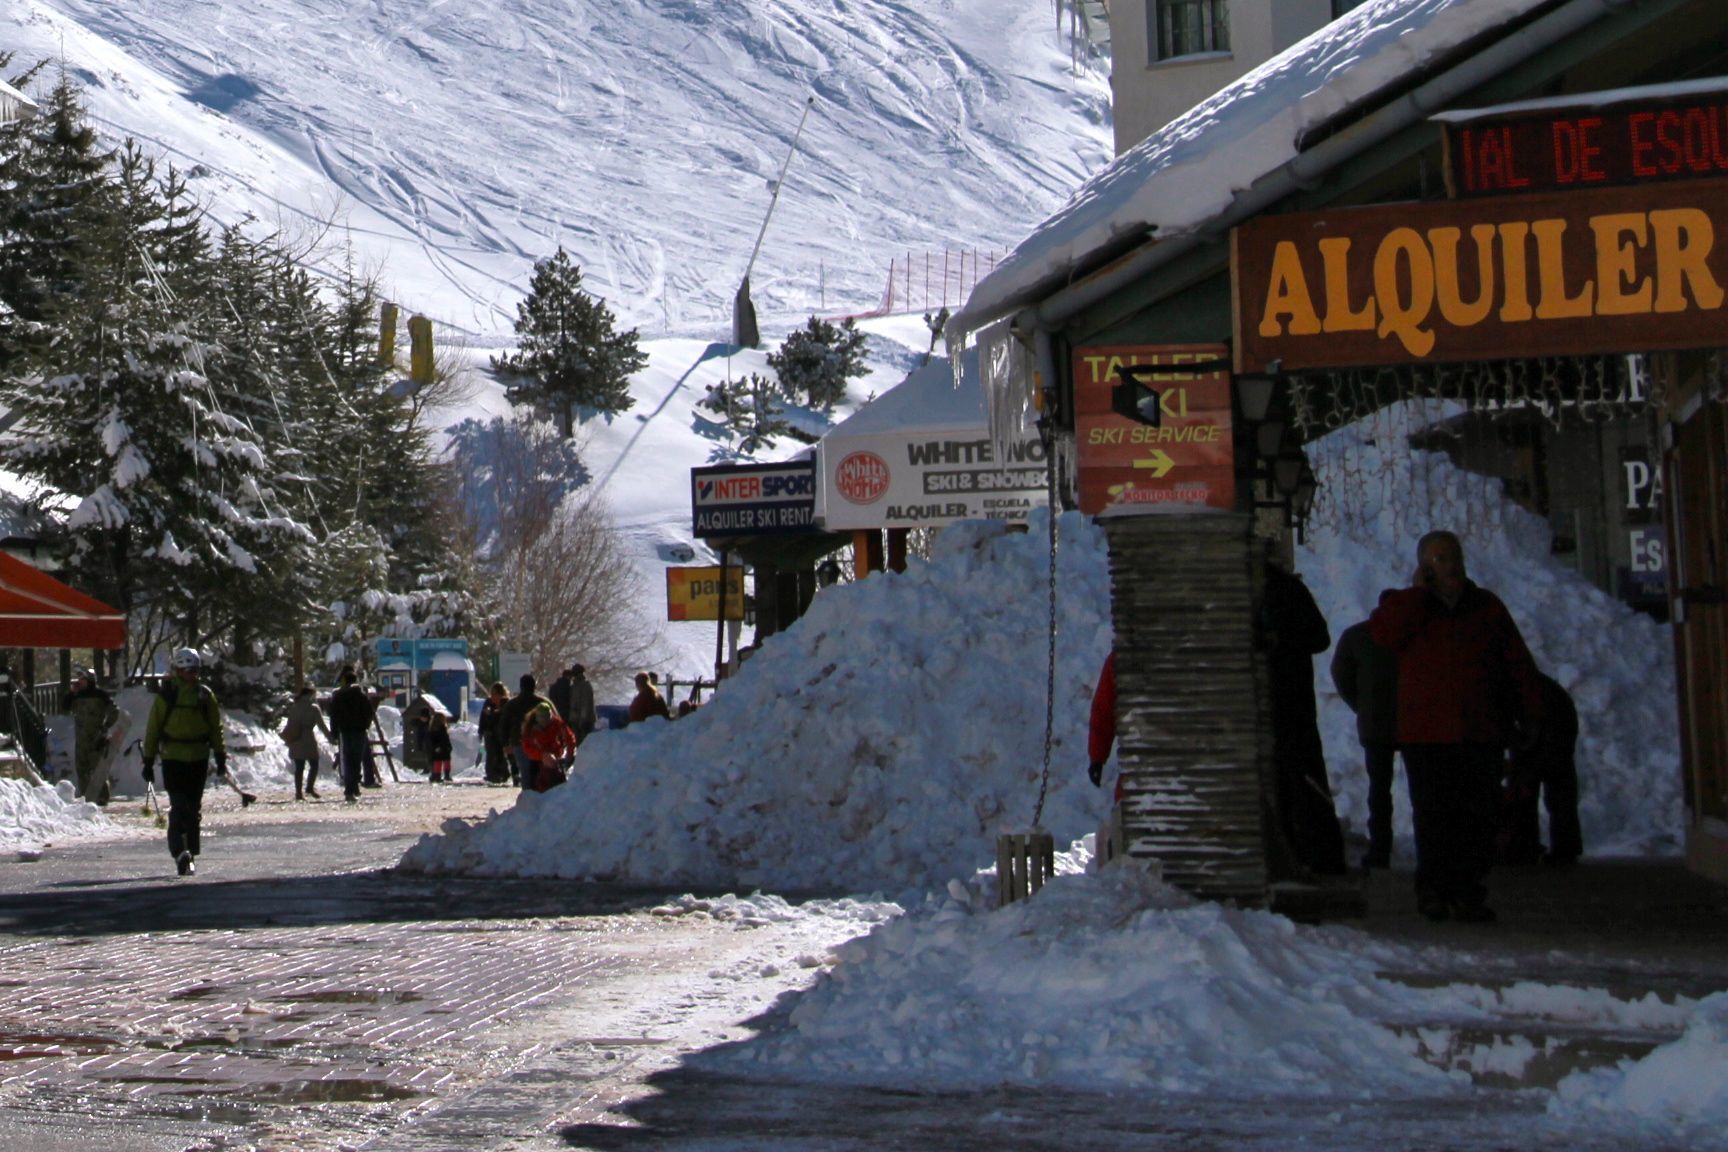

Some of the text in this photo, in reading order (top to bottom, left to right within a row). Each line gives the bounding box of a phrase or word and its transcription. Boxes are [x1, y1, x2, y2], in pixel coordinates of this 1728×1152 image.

[1553, 118, 1607, 183] DE
[1259, 208, 1725, 357] ALQUILER
[1084, 353, 1220, 383] TALLER
[1159, 387, 1188, 418] KI
[1088, 425, 1222, 445] SKI SERVICE
[907, 439, 994, 466] WHITE
[927, 474, 958, 491] SKI
[886, 503, 968, 521] ALQUILER
[983, 498, 1030, 509] ESCUELA
[697, 510, 754, 530] ALQUILER
[757, 508, 777, 528] SKI
